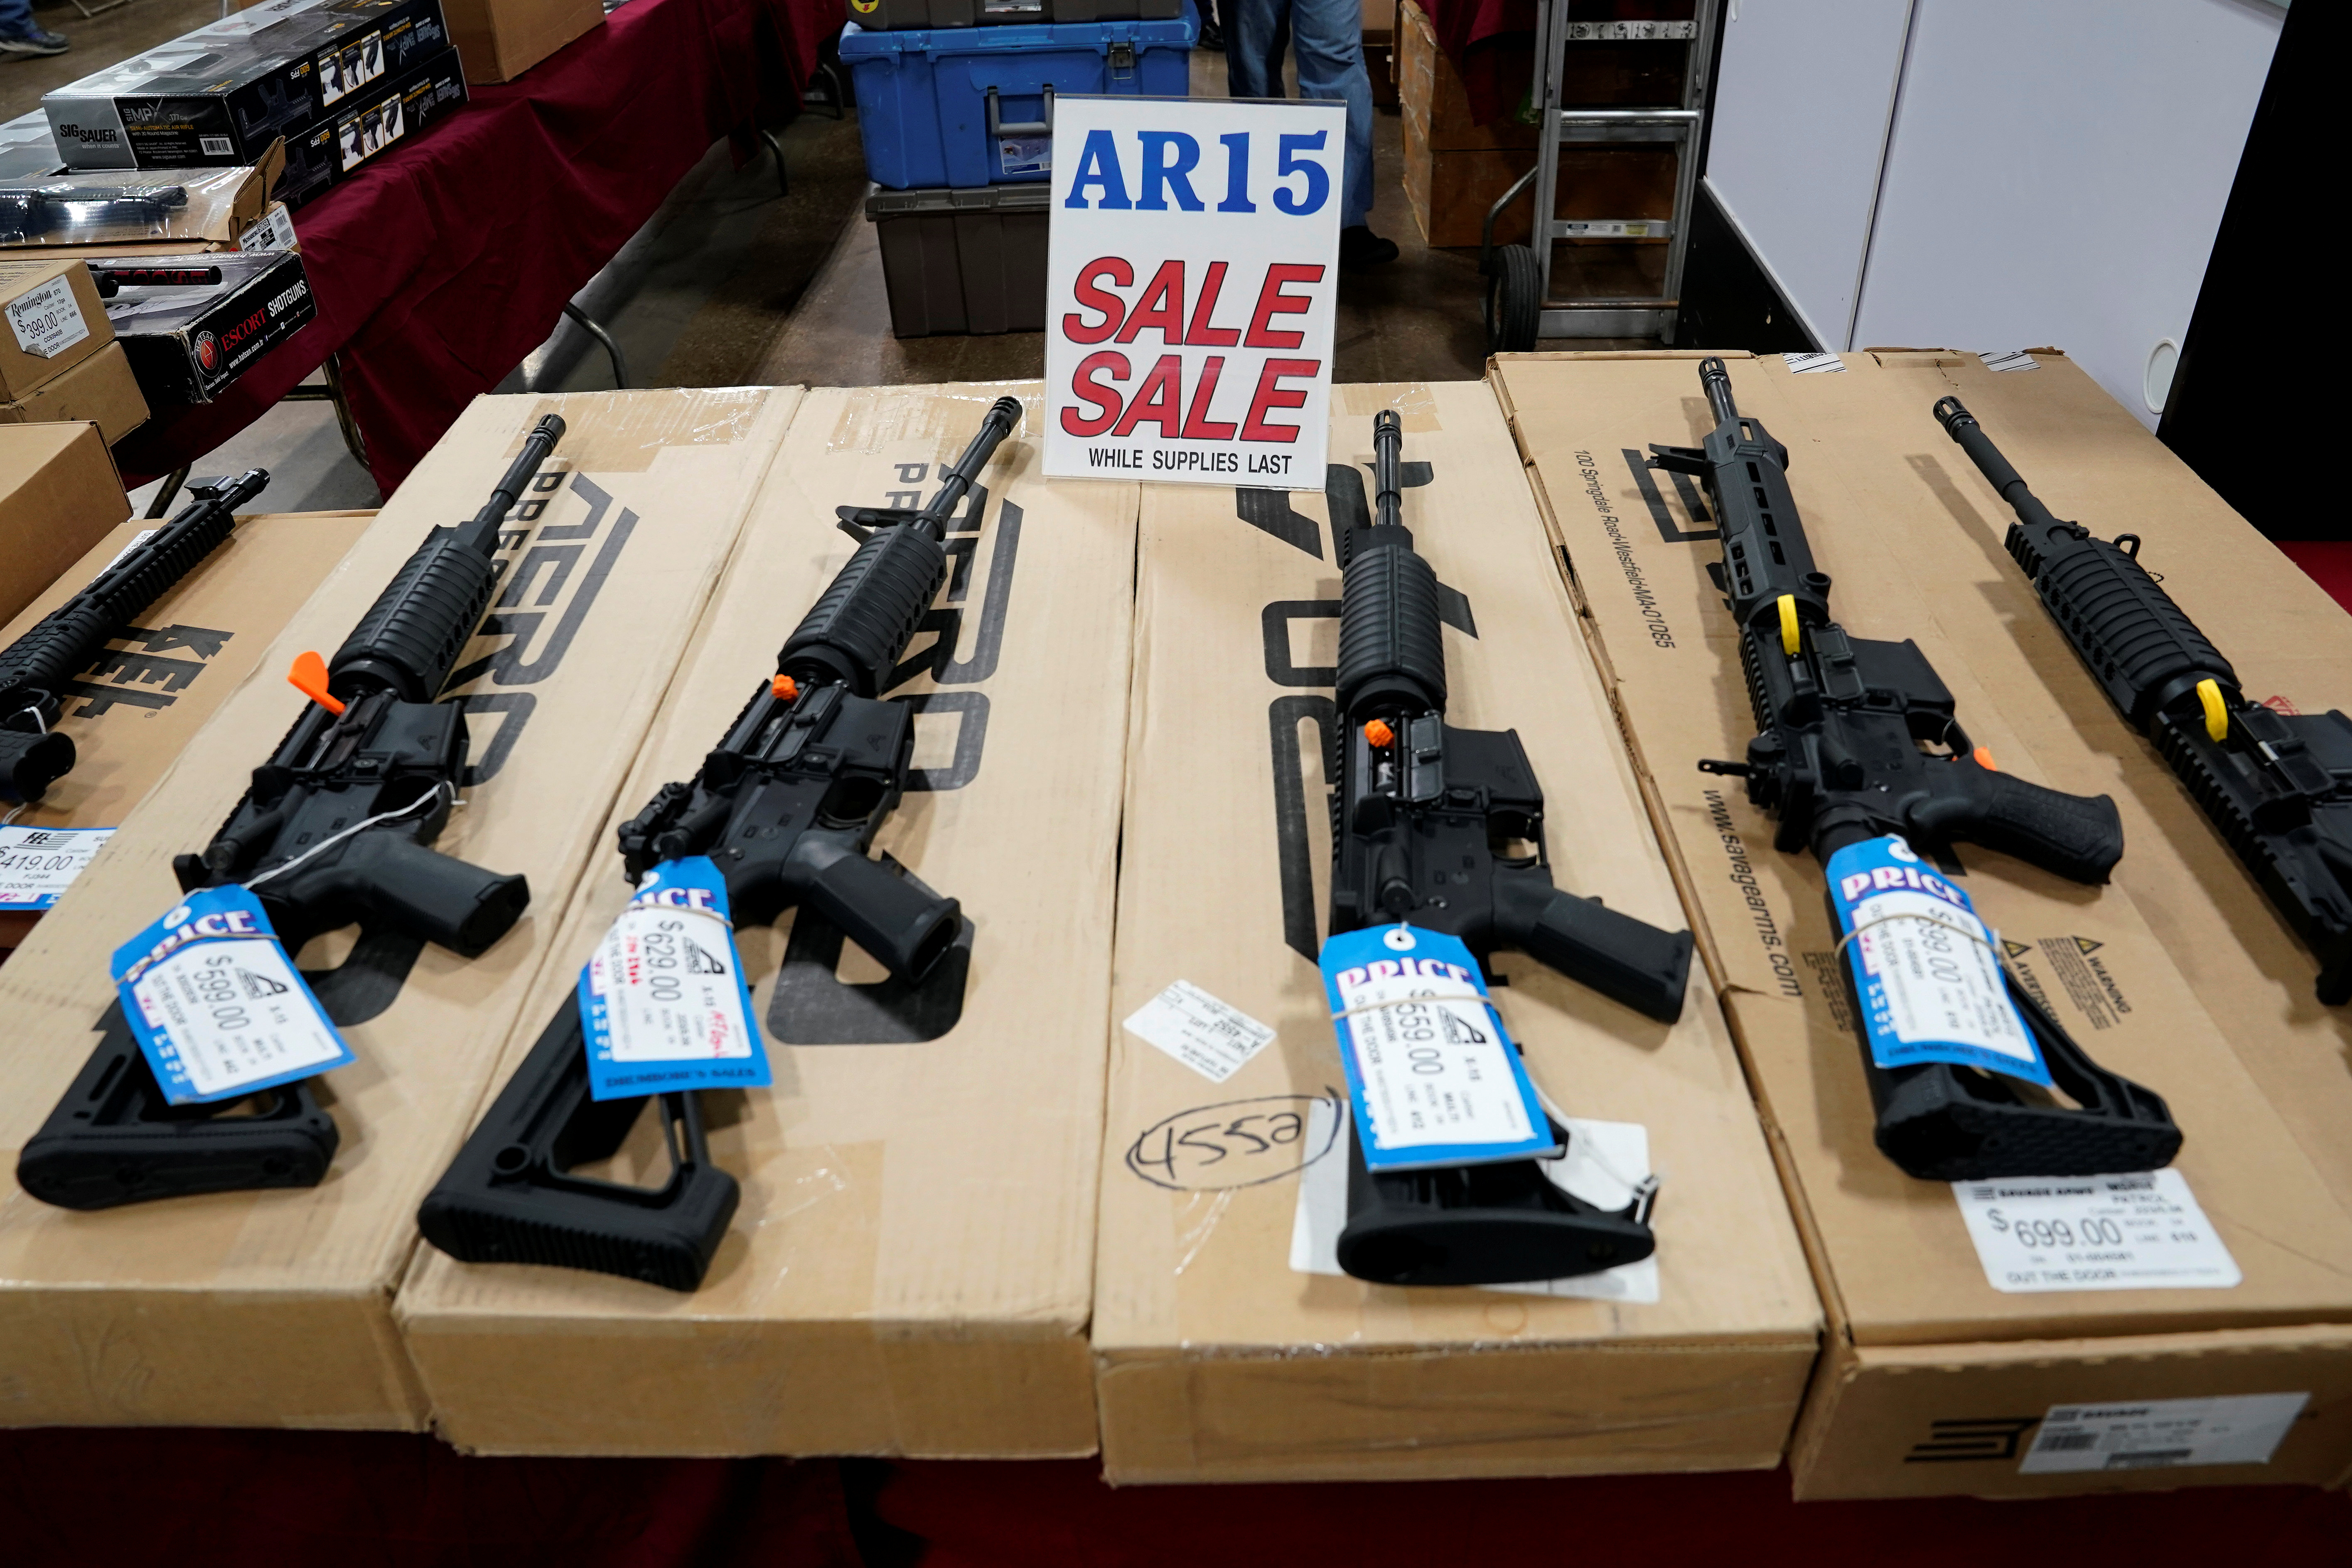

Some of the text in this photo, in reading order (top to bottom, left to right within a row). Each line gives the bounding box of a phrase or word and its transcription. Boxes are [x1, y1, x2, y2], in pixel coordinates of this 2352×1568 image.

[290, 69, 300, 79] FPS
[60, 124, 79, 137] SIG
[80, 129, 117, 142] SAUER
[310, 137, 320, 147] FPS
[1064, 130, 1330, 216] AR15
[11, 290, 52, 317] Remington
[44, 302, 54, 310] Caliber
[221, 308, 266, 351] ESCORT
[268, 280, 306, 317] SHOTGUNS
[1062, 256, 1326, 349] SALE
[48, 342, 60, 353] DOOR
[196, 333, 214, 352] HATSAN
[229, 339, 263, 369] www.hatsan.com.tr
[1060, 350, 1321, 443] SALE
[1089, 447, 1293, 475] WHILE SUPPLIES LAST
[1574, 450, 1594, 468] 100
[1582, 468, 1610, 514] Springdale
[1841, 866, 1968, 908] PRICE
